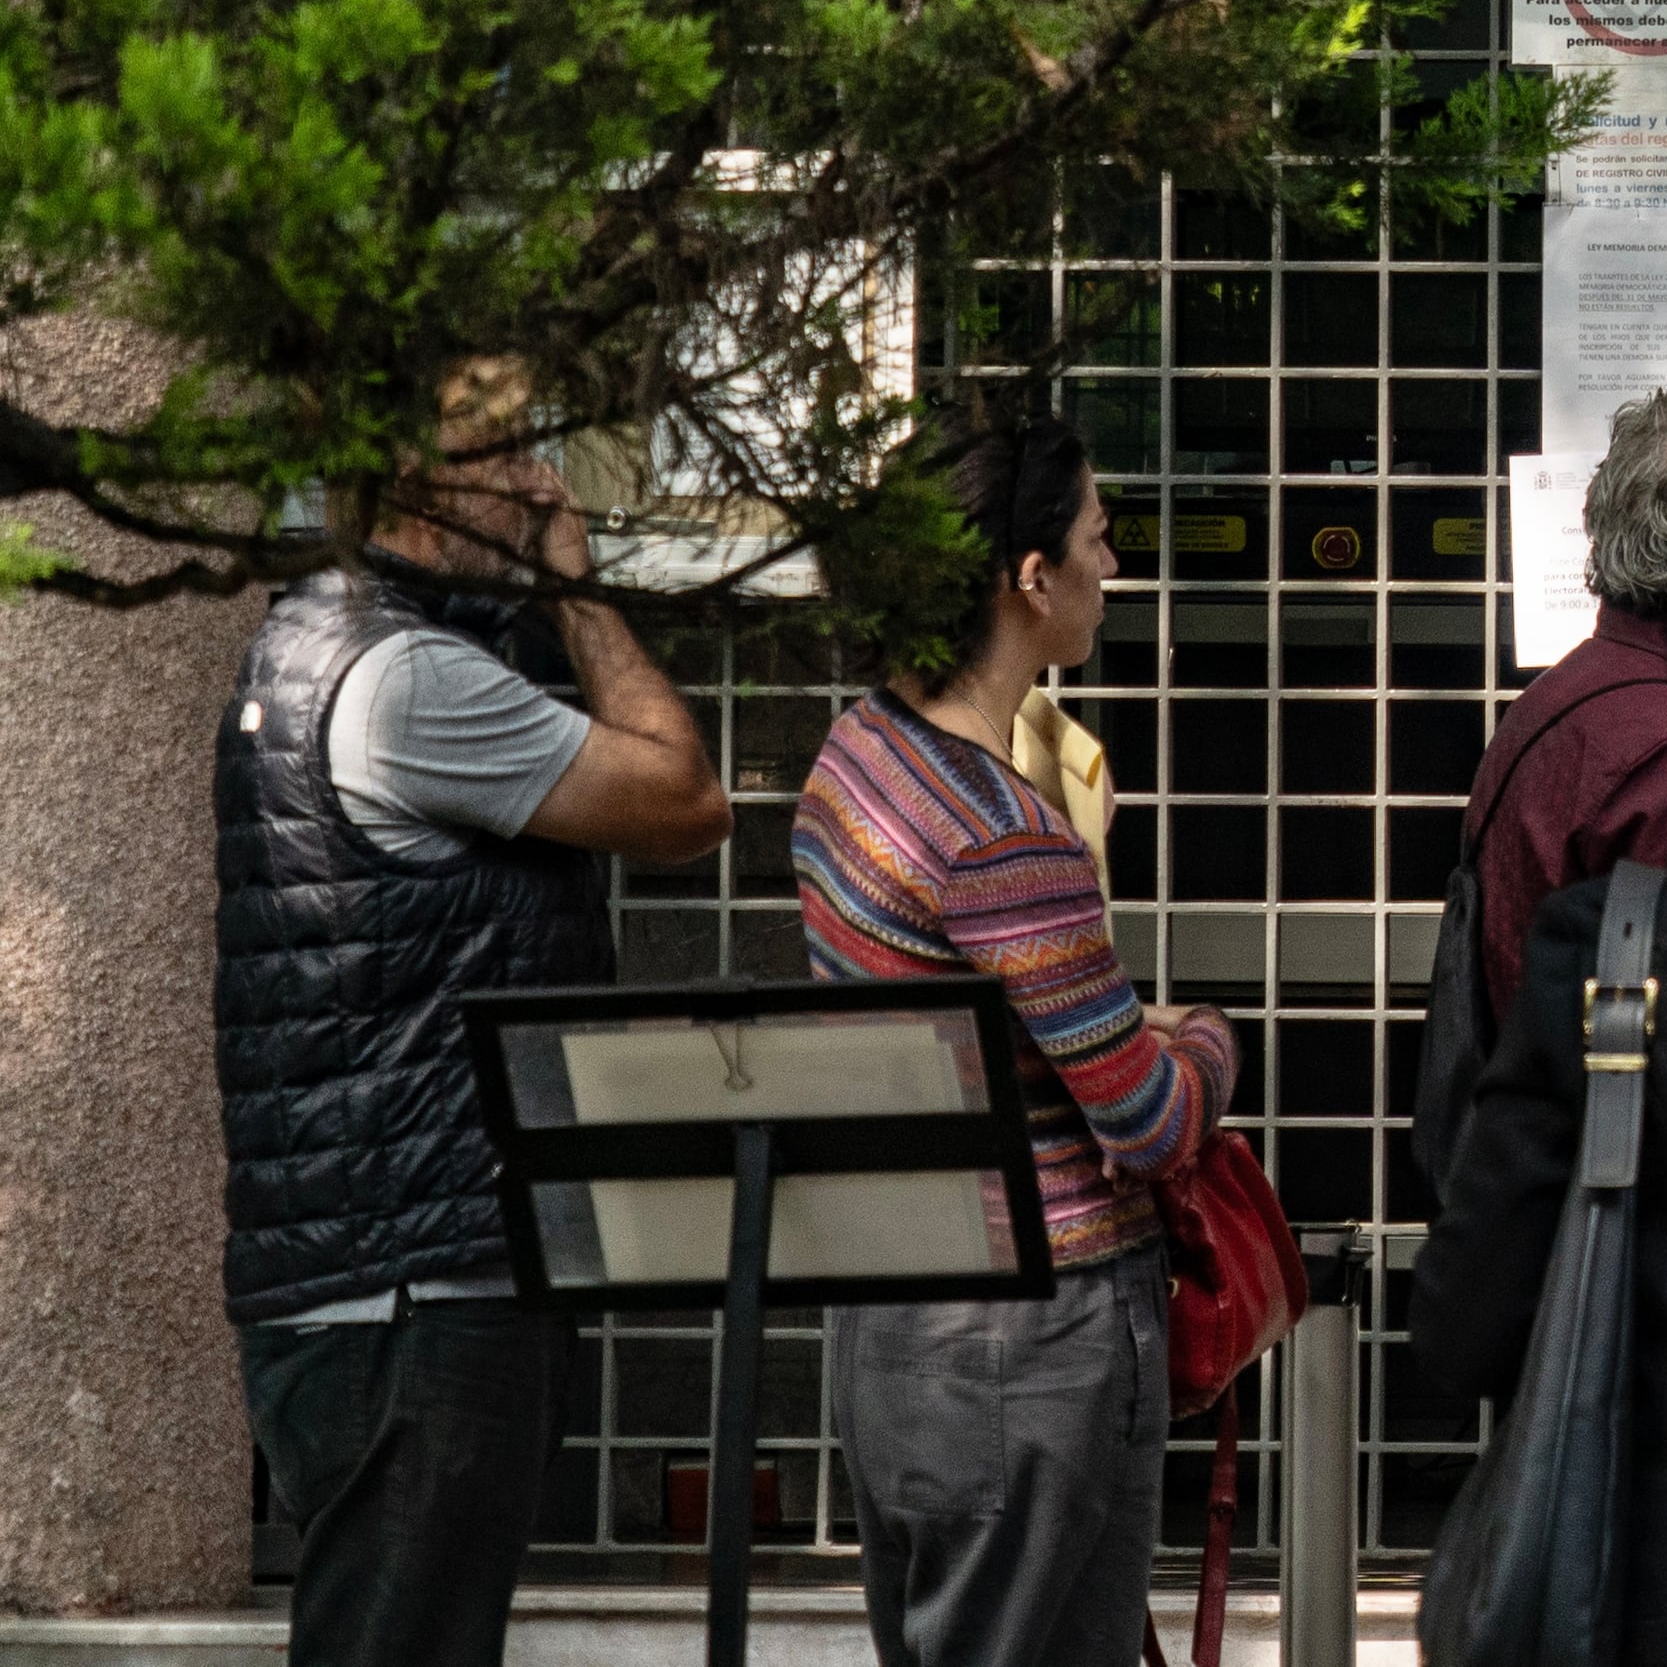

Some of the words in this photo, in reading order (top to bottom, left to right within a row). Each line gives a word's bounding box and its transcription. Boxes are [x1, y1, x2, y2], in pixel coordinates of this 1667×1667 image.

[1549, 15, 1571, 26] los
[1576, 15, 1633, 26] mismos
[1567, 38, 1657, 50] permanecer
[1576, 114, 1641, 128] licitud
[1649, 117, 1657, 129] y
[1576, 133, 1616, 146] ctas
[1620, 132, 1644, 145] del
[1576, 155, 1589, 163] Se
[1593, 155, 1627, 164] podrán
[1631, 155, 1667, 163] solicitar
[1576, 170, 1589, 178] DE
[1593, 170, 1643, 178] REGISTRO
[1576, 184, 1608, 193] lunes
[1603, 244, 1646, 252] MEMORIA
